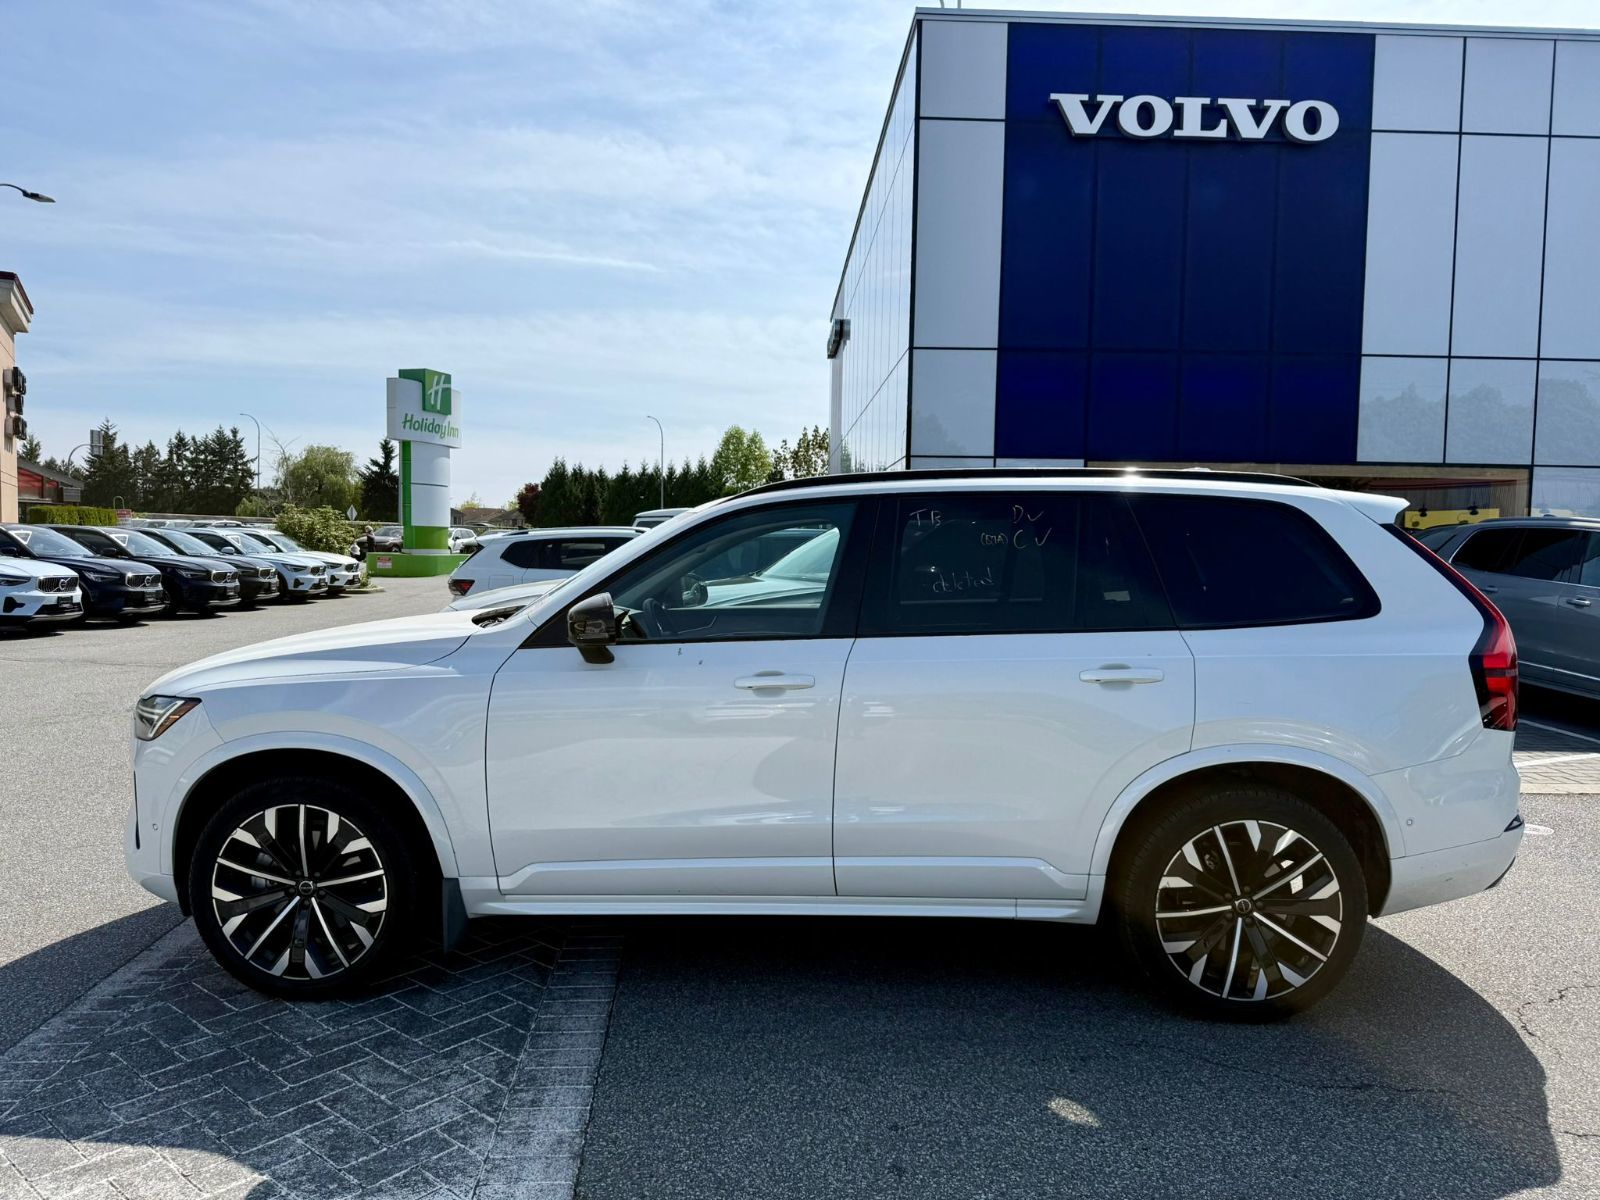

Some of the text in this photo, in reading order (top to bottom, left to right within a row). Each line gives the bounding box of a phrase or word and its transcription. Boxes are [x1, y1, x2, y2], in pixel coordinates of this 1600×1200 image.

[1049, 92, 1340, 143] VOLVO
[401, 412, 459, 439] Holiday Inn
